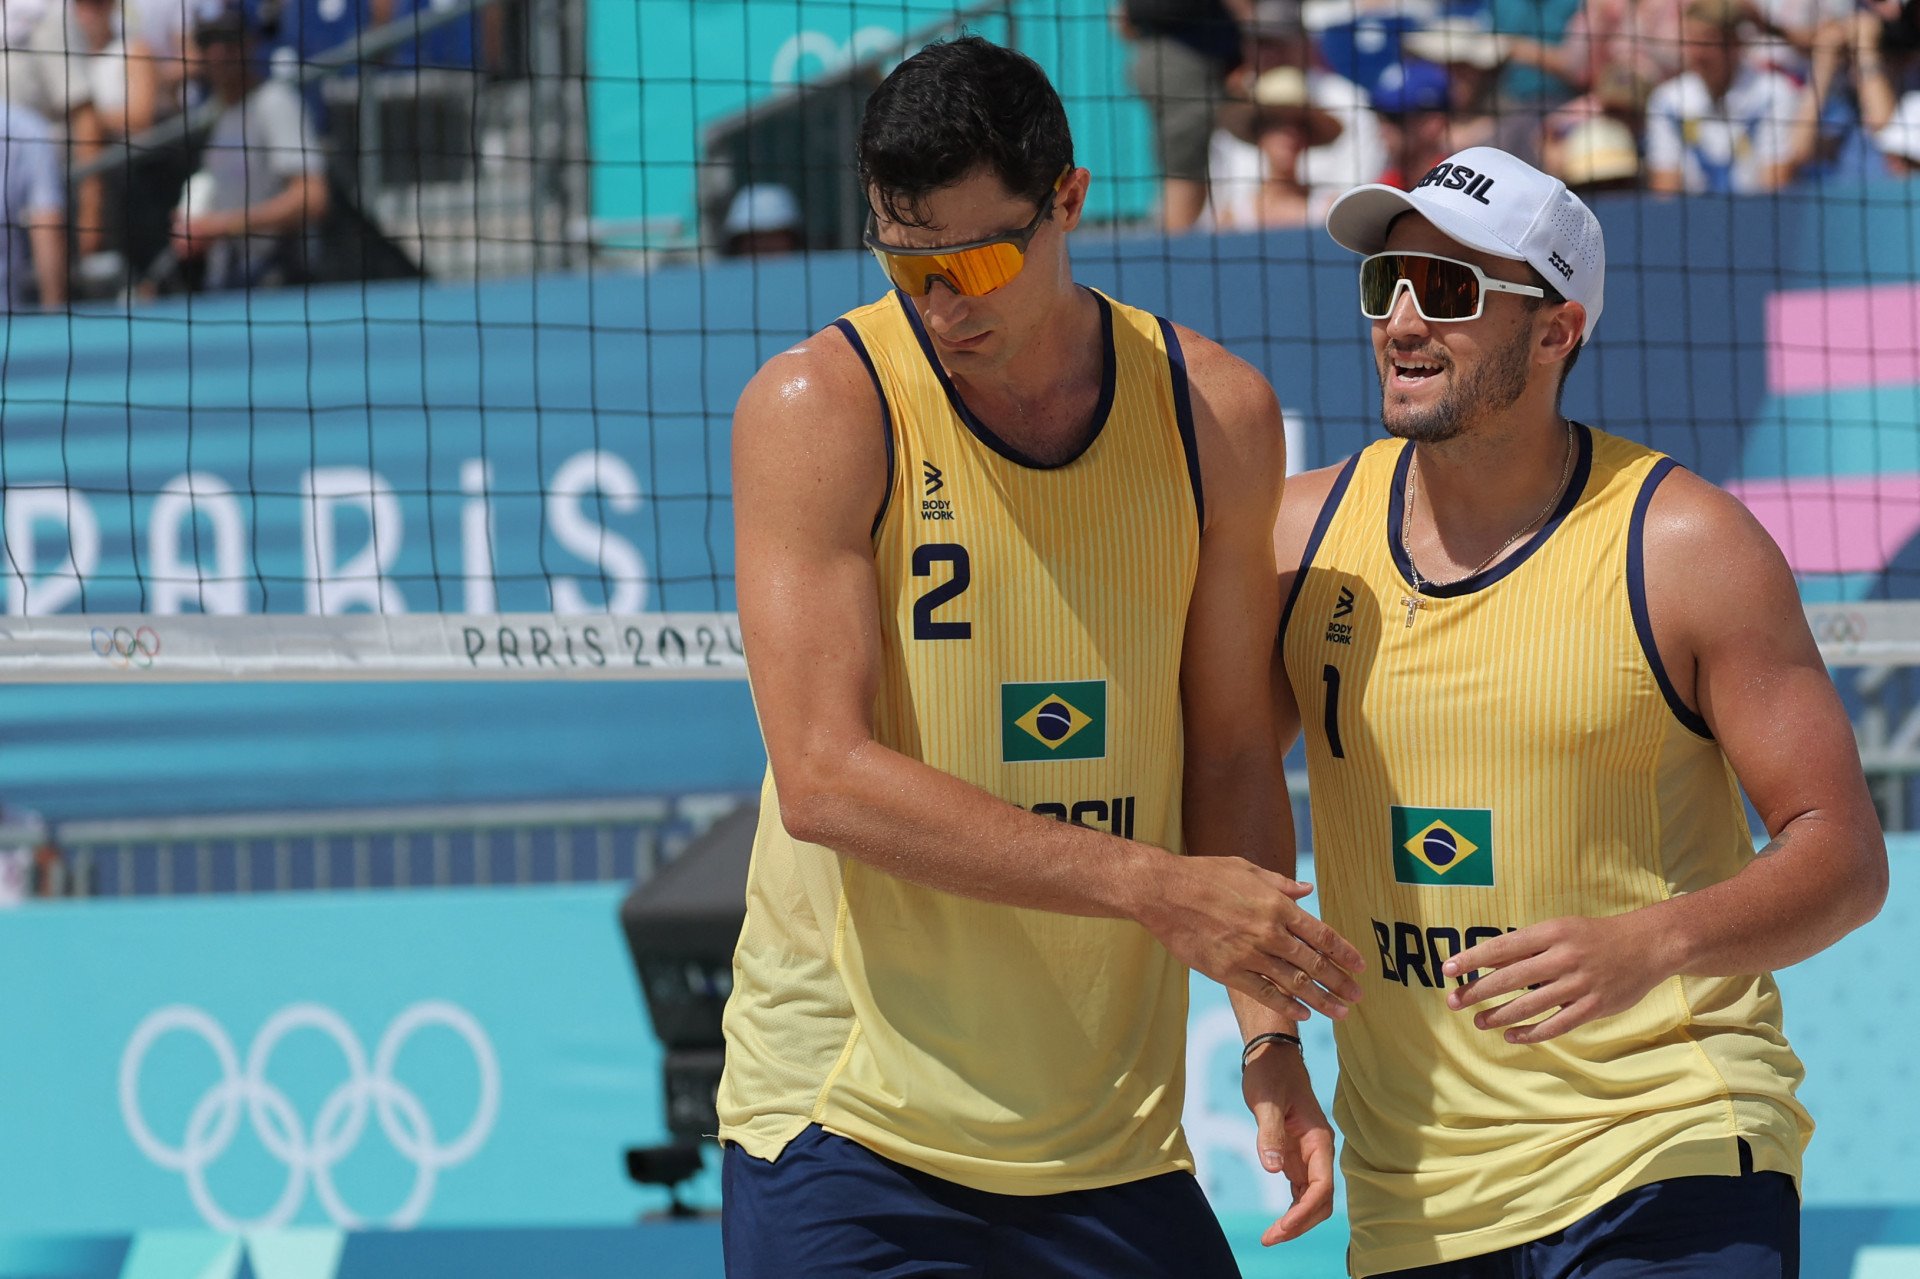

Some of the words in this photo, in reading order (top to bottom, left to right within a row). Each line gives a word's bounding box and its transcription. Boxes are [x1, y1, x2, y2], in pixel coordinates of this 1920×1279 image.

[922, 500, 951, 510] BODY
[921, 511, 955, 521] WORK
[912, 543, 972, 640] 2
[1328, 622, 1353, 634] BODY
[1325, 632, 1352, 645] WORK
[1322, 664, 1345, 759] 1
